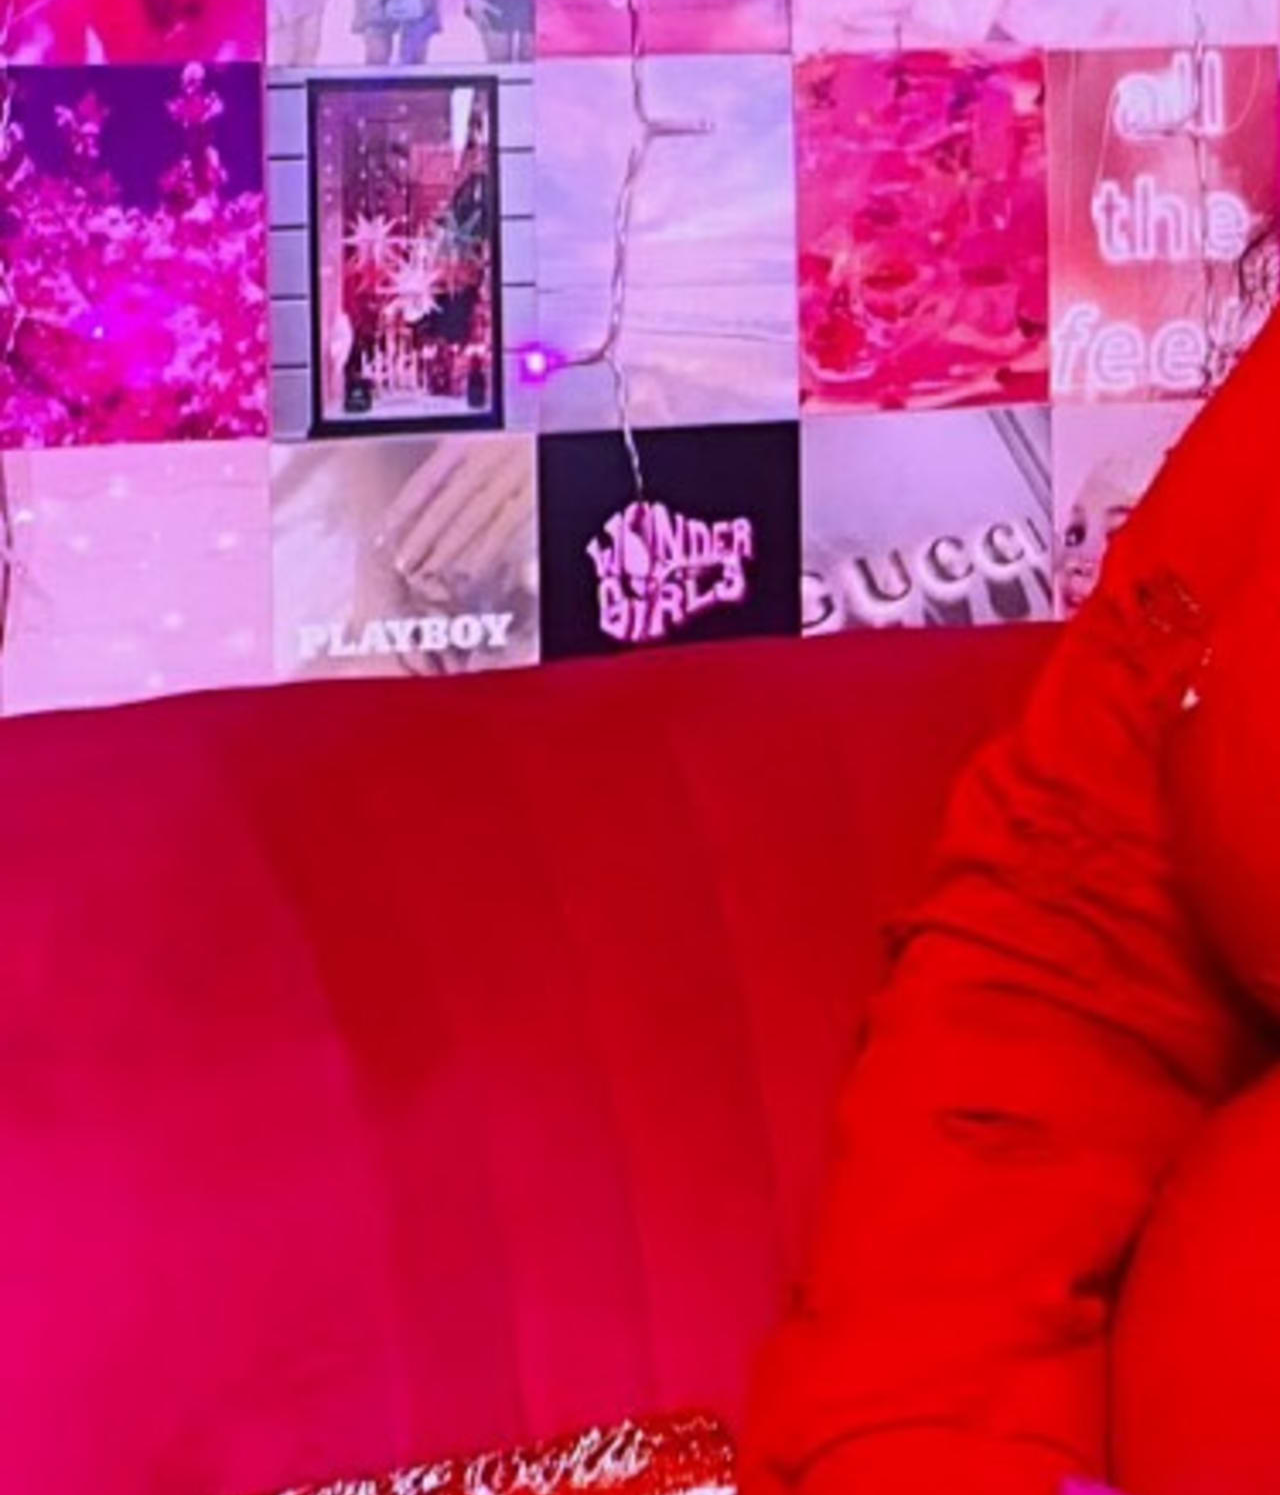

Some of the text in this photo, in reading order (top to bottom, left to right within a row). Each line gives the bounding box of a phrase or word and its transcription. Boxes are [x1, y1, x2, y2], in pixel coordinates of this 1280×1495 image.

[1113, 50, 1226, 142] all
[1092, 175, 1252, 264] the
[586, 501, 753, 579] WONDER
[801, 518, 1049, 628] GUCCI
[297, 612, 513, 659] PLAYBOY
[598, 556, 746, 642] GIRLS
